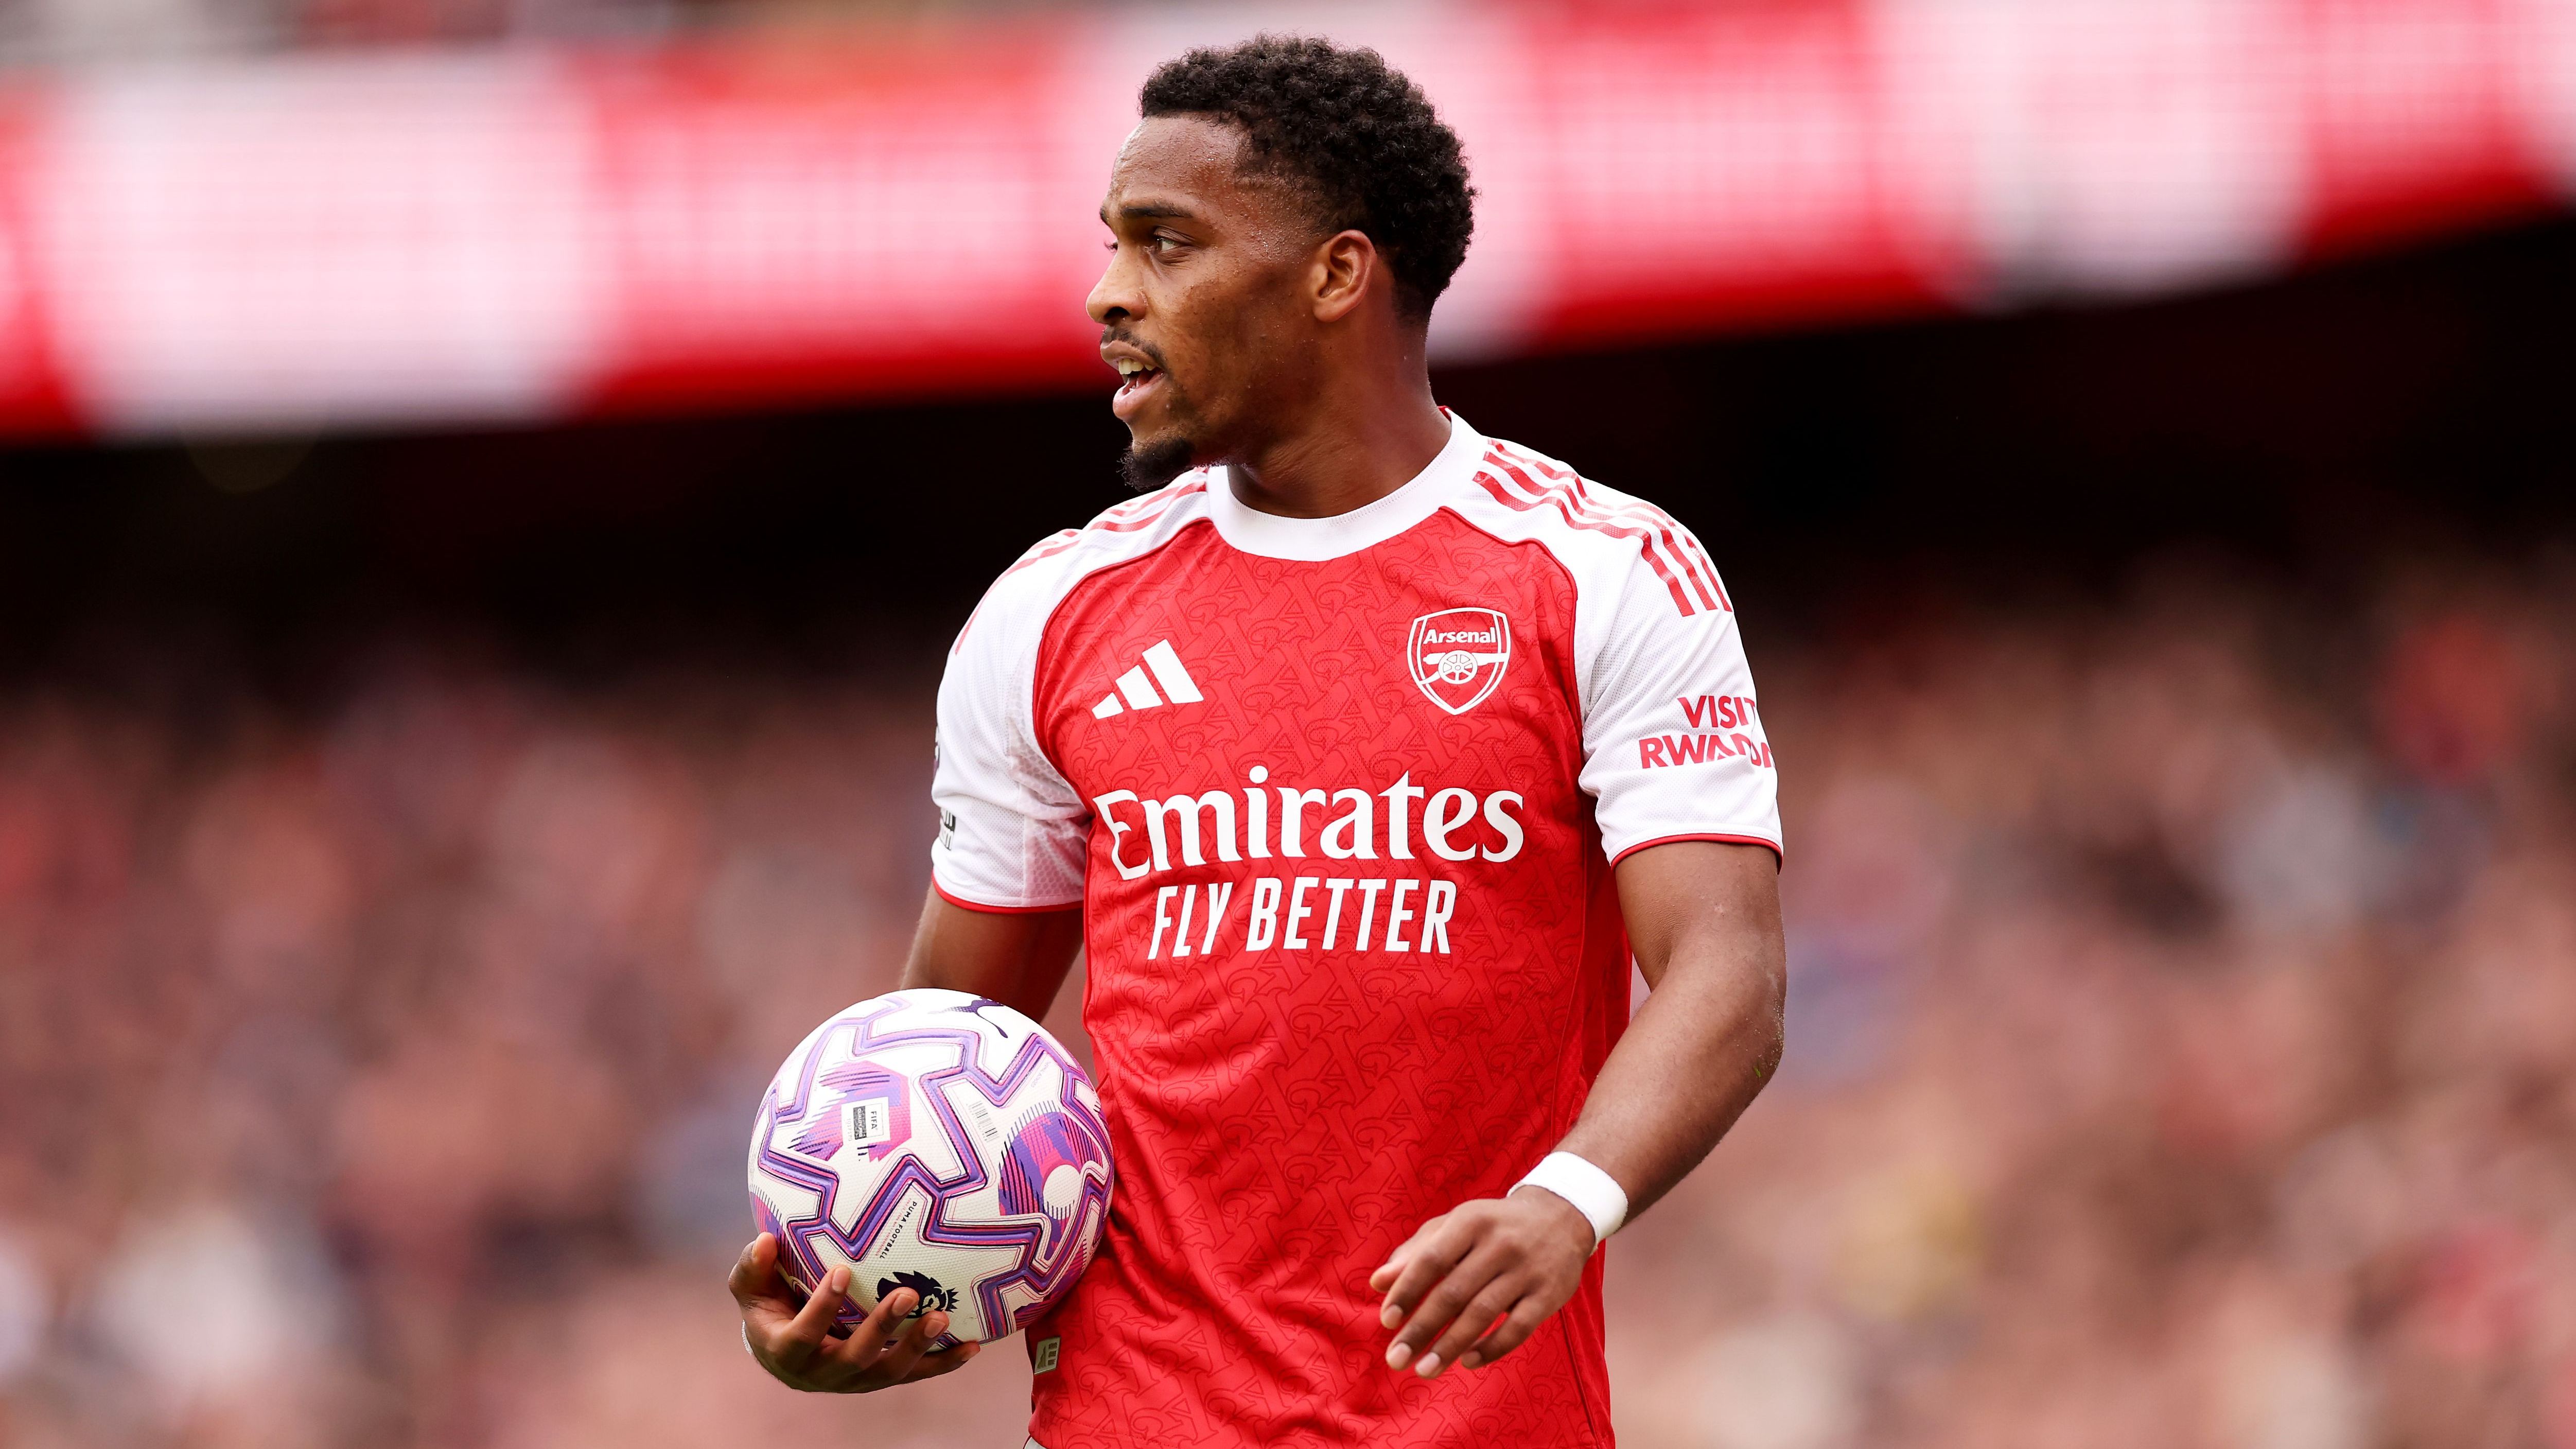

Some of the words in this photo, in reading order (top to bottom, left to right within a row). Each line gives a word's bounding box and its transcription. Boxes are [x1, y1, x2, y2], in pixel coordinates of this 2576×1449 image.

[1423, 627, 1496, 644] Arsenal
[1092, 765, 1524, 880] Emirates
[1148, 883, 1234, 959] FLY
[1246, 877, 1457, 954] BETTER
[901, 1201, 917, 1223] PUMA
[880, 1224, 903, 1259] FOOTBALL
